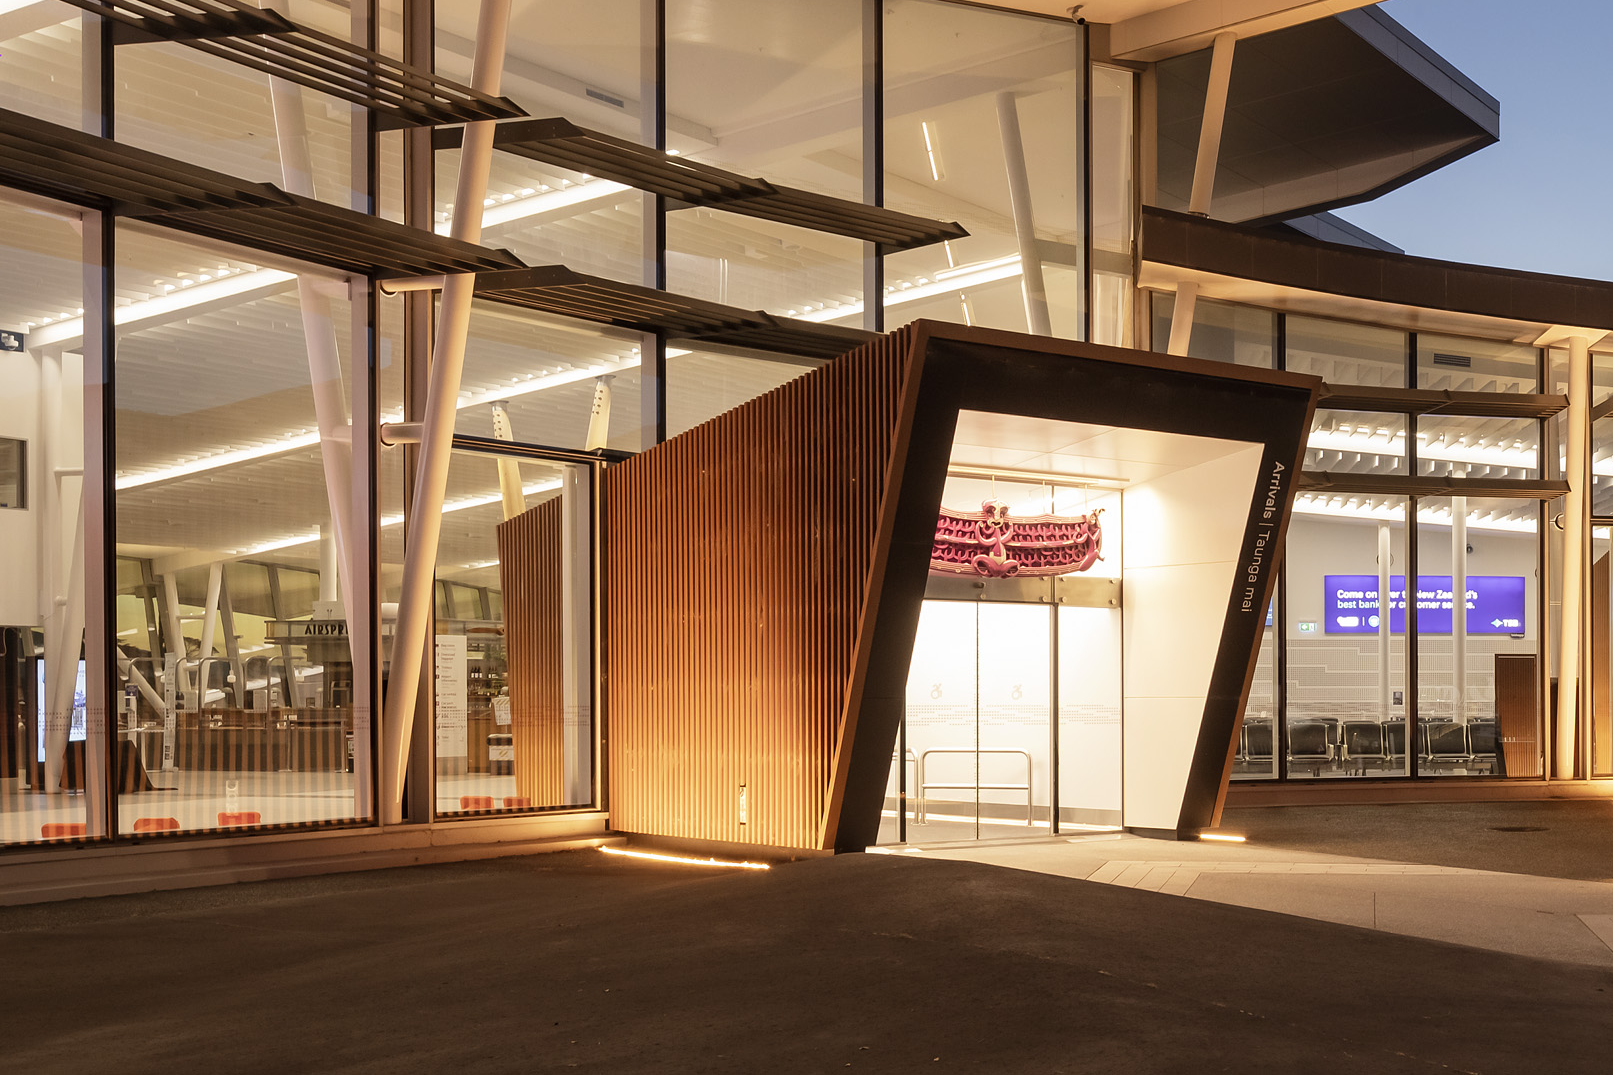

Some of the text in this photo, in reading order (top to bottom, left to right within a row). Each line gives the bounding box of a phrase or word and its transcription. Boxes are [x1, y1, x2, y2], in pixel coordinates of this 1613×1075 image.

[1241, 461, 1285, 612] Arrivals Taunga mai
[1336, 589, 1364, 599] Come
[1365, 591, 1378, 599] on
[1436, 589, 1478, 600] Zead's
[1337, 599, 1357, 609] best
[1359, 599, 1380, 609] bank
[1398, 601, 1441, 609] comer
